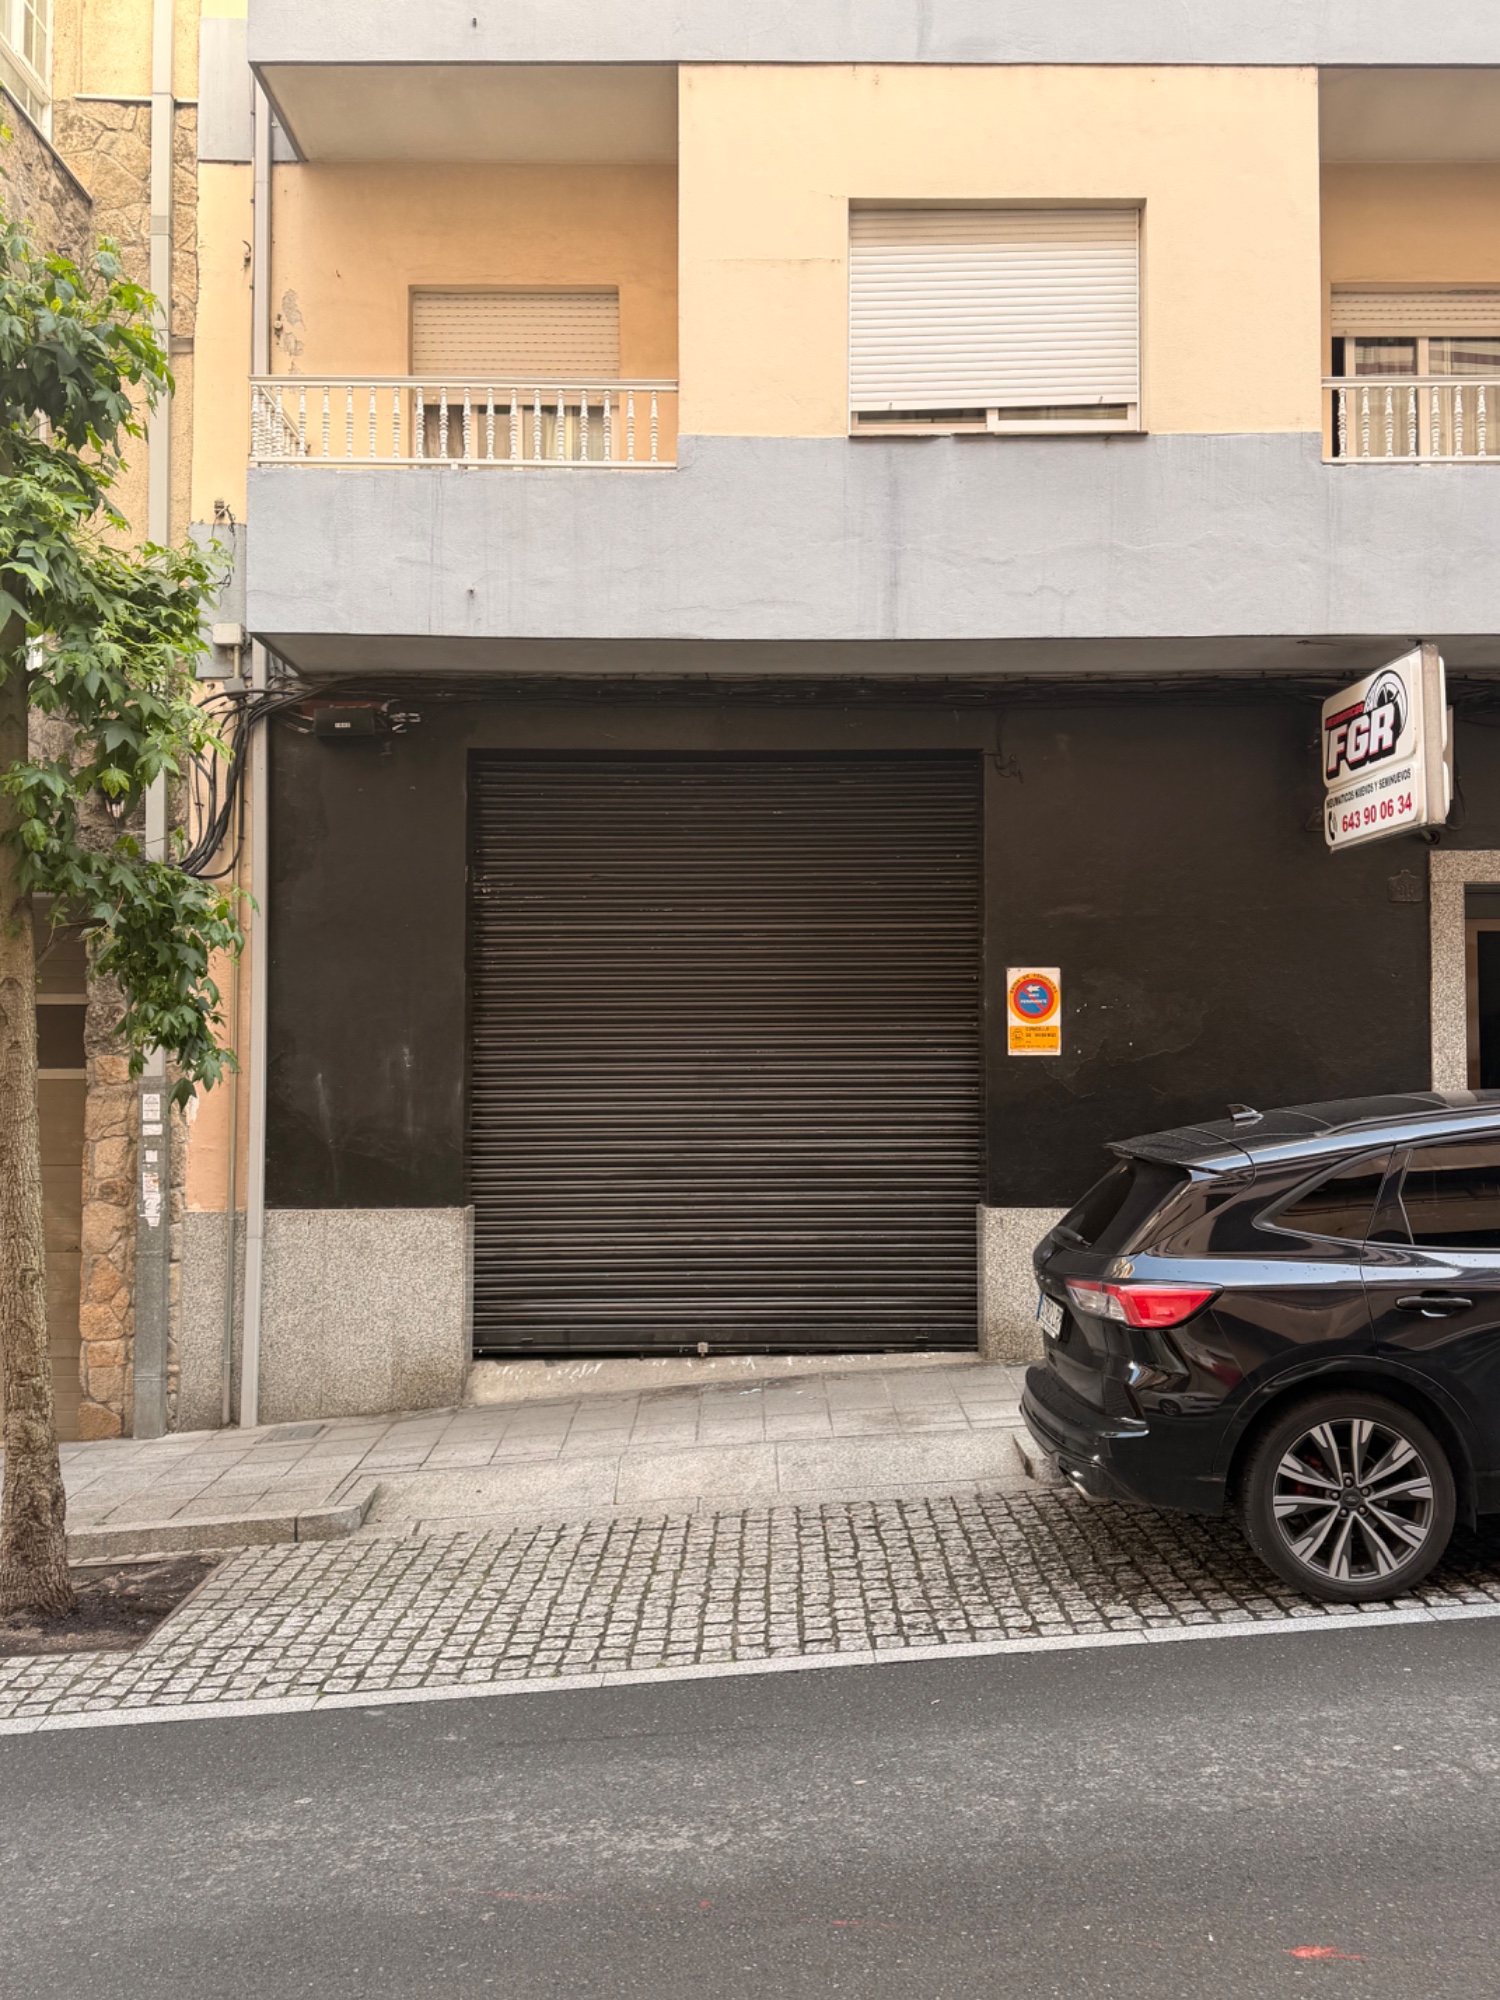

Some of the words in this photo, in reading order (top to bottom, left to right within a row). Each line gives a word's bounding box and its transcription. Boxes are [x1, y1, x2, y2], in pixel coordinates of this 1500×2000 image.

[1327, 702, 1395, 778] FGR
[1355, 782, 1374, 798] NUEVOS
[1379, 768, 1411, 789] SEMINUEVOS
[1342, 810, 1361, 832] 643
[1363, 804, 1377, 825] 90
[1380, 798, 1394, 819] 06
[1398, 791, 1412, 814] 34
